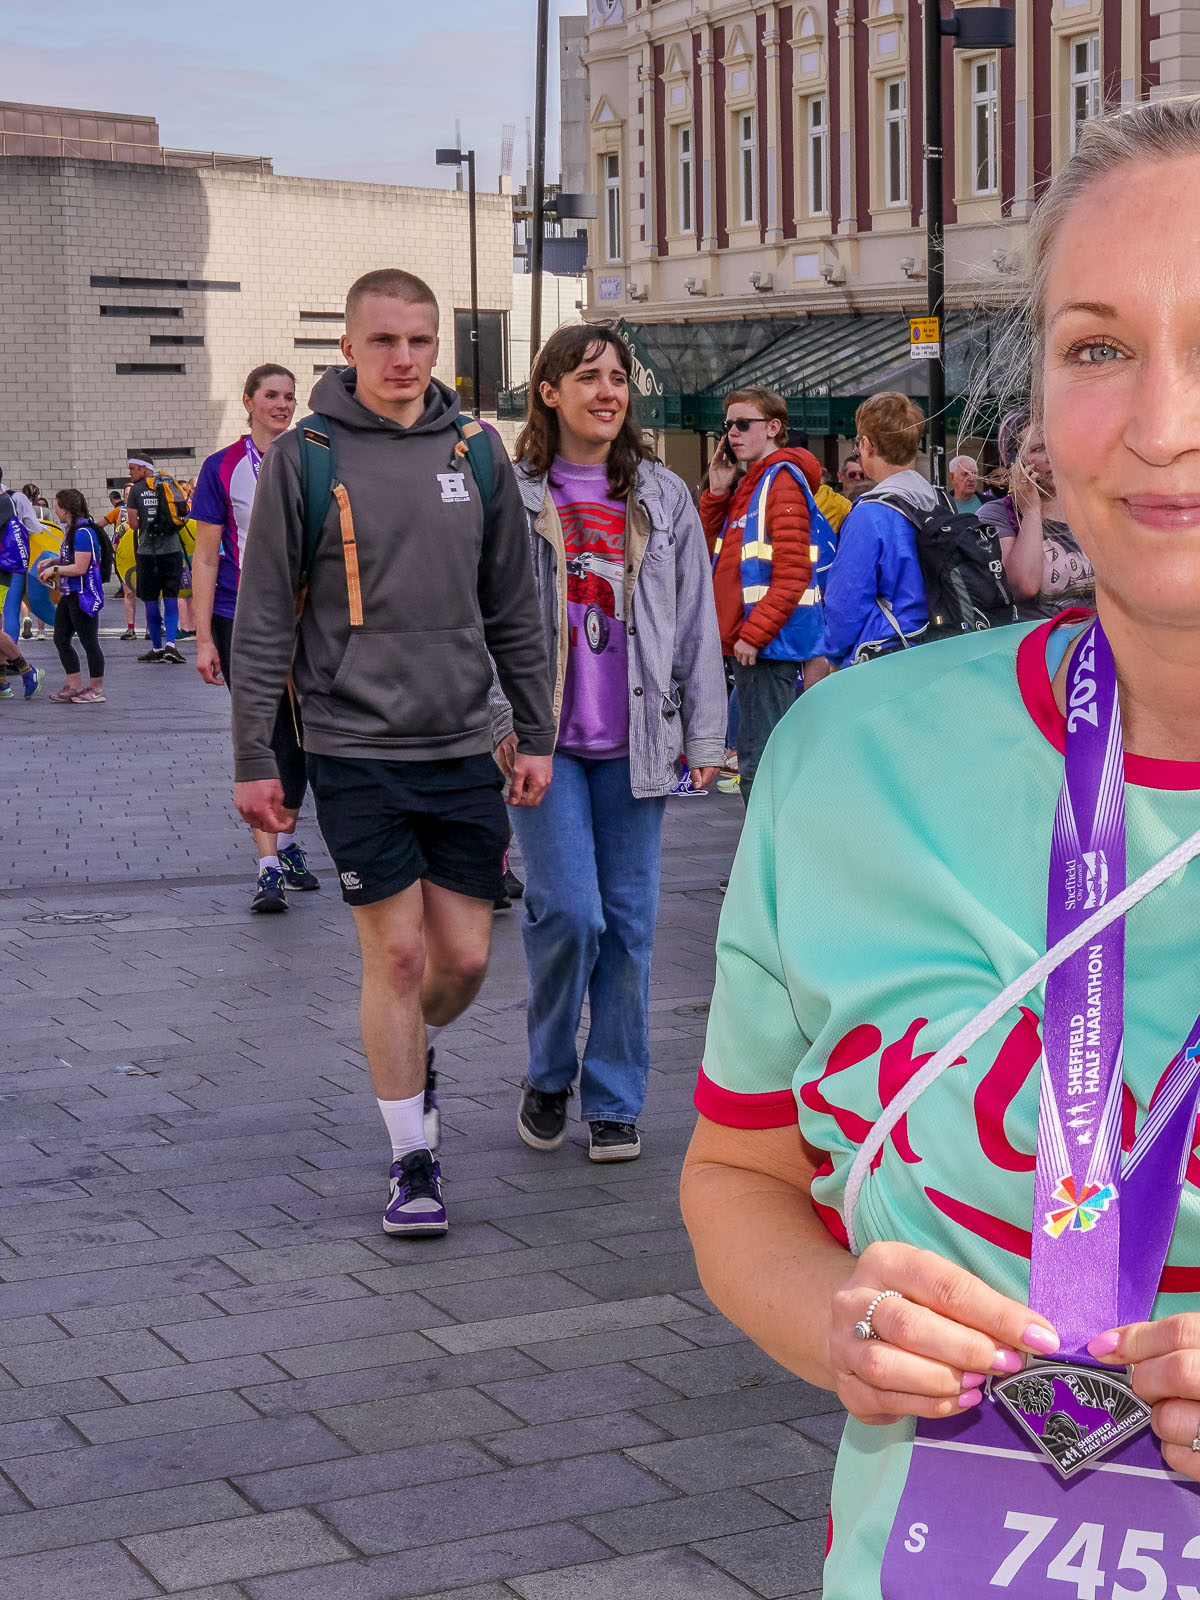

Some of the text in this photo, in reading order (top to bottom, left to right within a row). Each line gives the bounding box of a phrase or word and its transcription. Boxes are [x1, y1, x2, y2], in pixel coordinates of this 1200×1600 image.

[14, 532, 23, 547] RUN
[1065, 859, 1076, 910] Sheffield
[1085, 944, 1103, 1093] HALF MARATHON
[1068, 1014, 1084, 1096] SHEFFIELD
[1077, 1422, 1112, 1449] SHEFFIELD
[1082, 1408, 1144, 1456] HALF MARATHON
[904, 1522, 929, 1553] S
